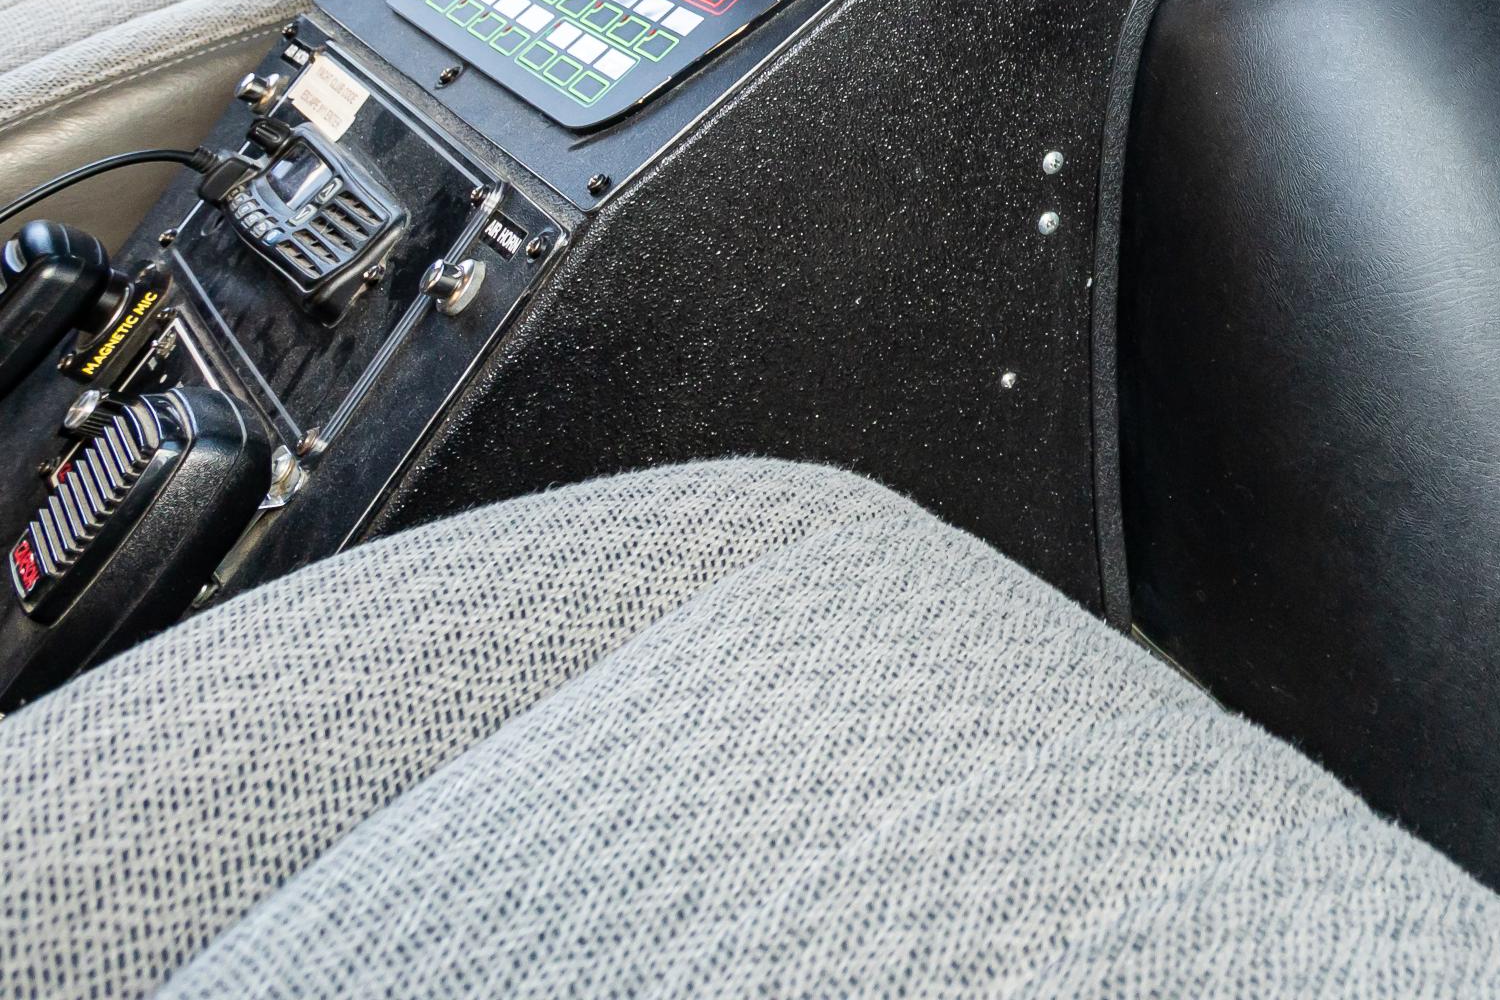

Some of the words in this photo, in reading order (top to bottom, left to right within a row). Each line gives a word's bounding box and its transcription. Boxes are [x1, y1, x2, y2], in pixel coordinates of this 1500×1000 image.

[484, 219, 503, 239] AIR
[496, 227, 523, 254] HORN
[81, 315, 139, 375] MAGNETIC
[132, 291, 158, 316] MIC
